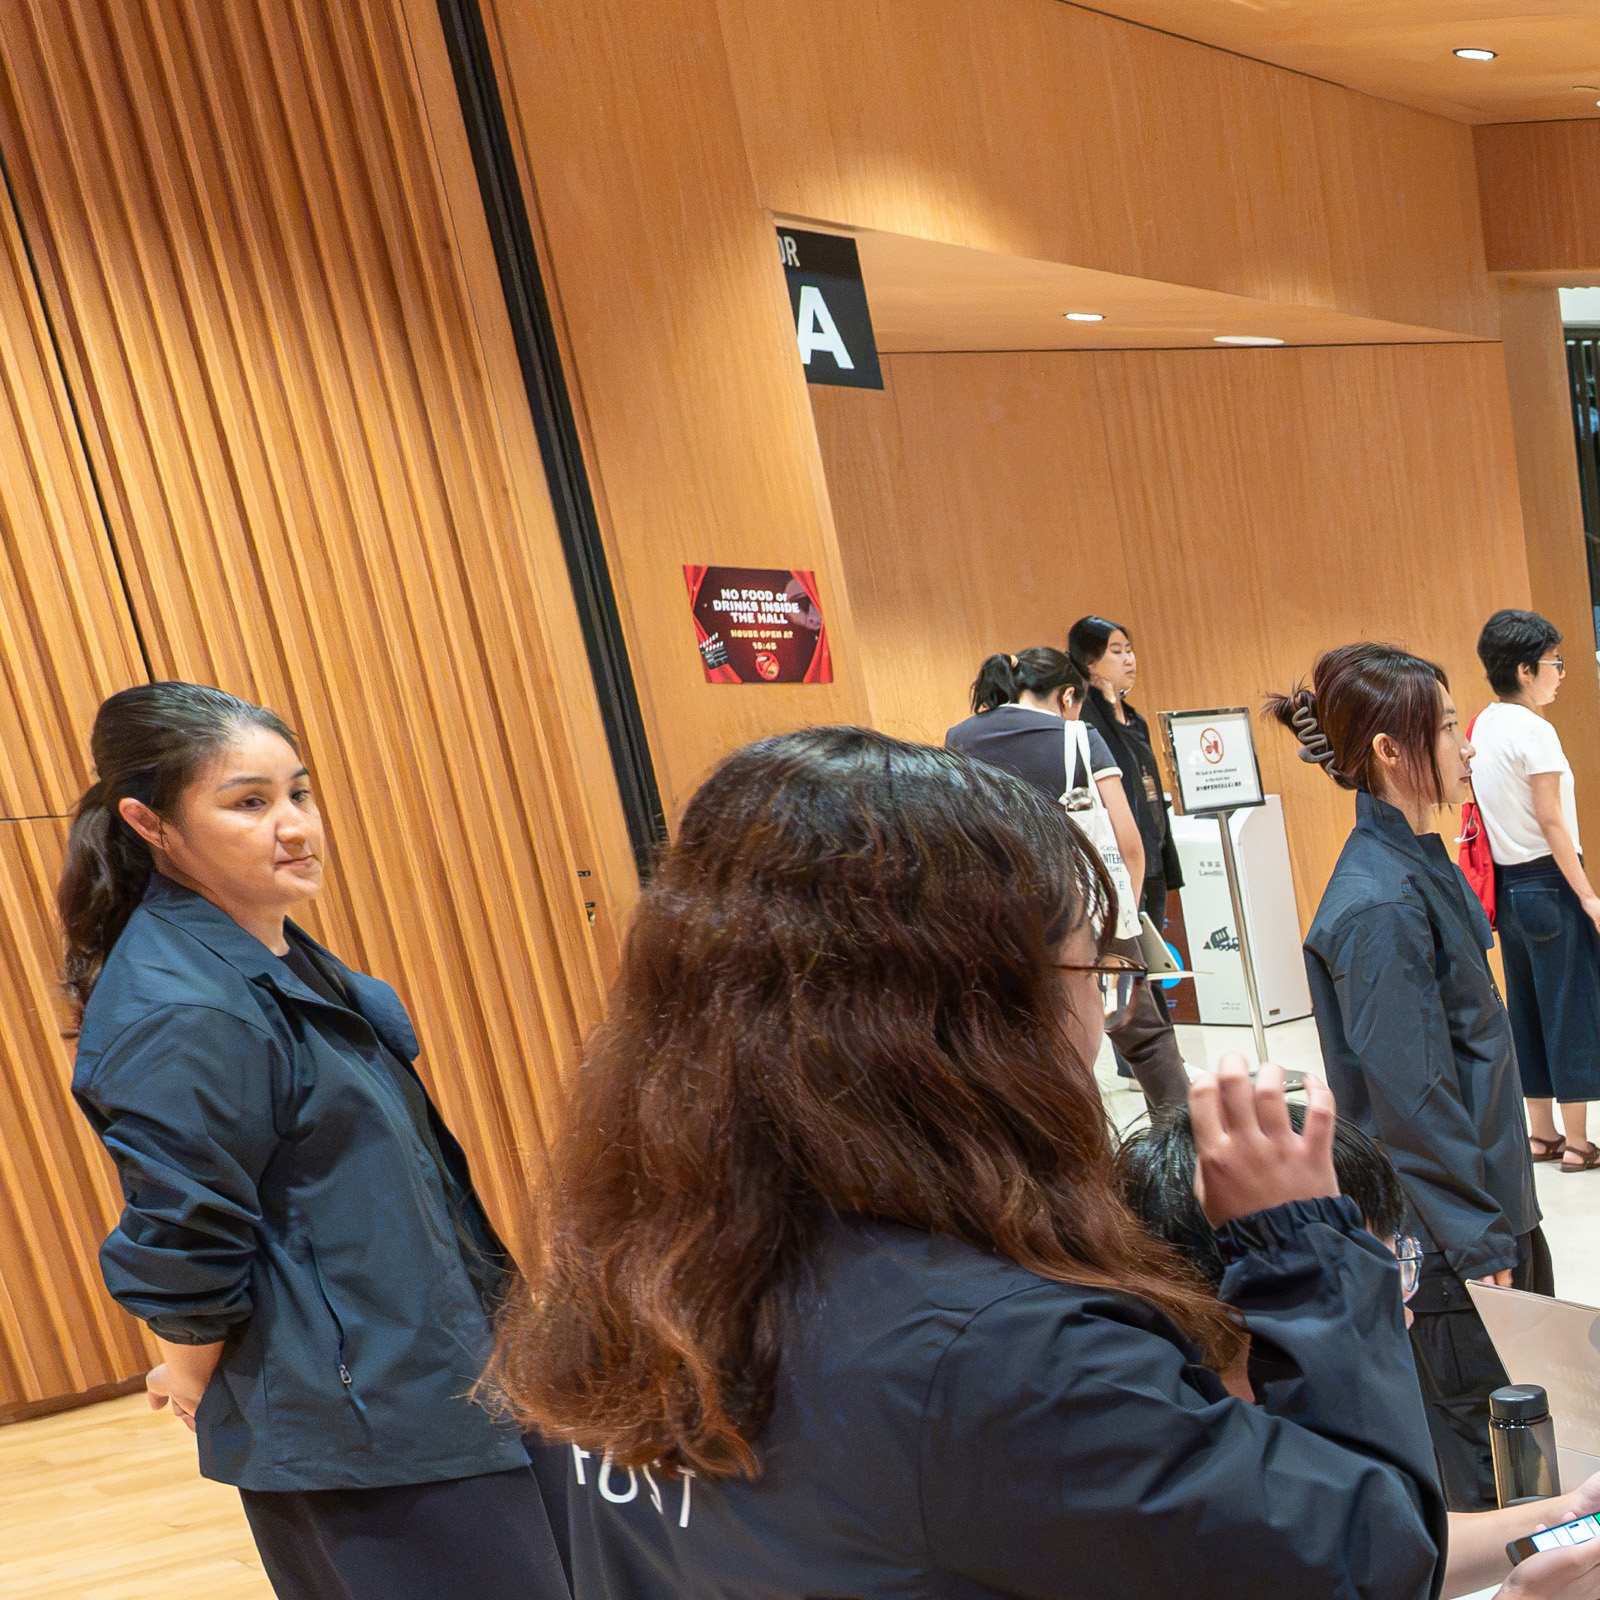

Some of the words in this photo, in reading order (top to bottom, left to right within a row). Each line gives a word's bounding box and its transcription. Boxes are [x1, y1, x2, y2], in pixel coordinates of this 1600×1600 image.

[797, 285, 855, 369] A
[721, 589, 739, 600] NO
[741, 590, 773, 601] FOOD
[713, 600, 758, 612] DRINKS
[761, 602, 799, 613] INSIDE
[730, 612, 755, 624] THE
[757, 613, 788, 624] HALL
